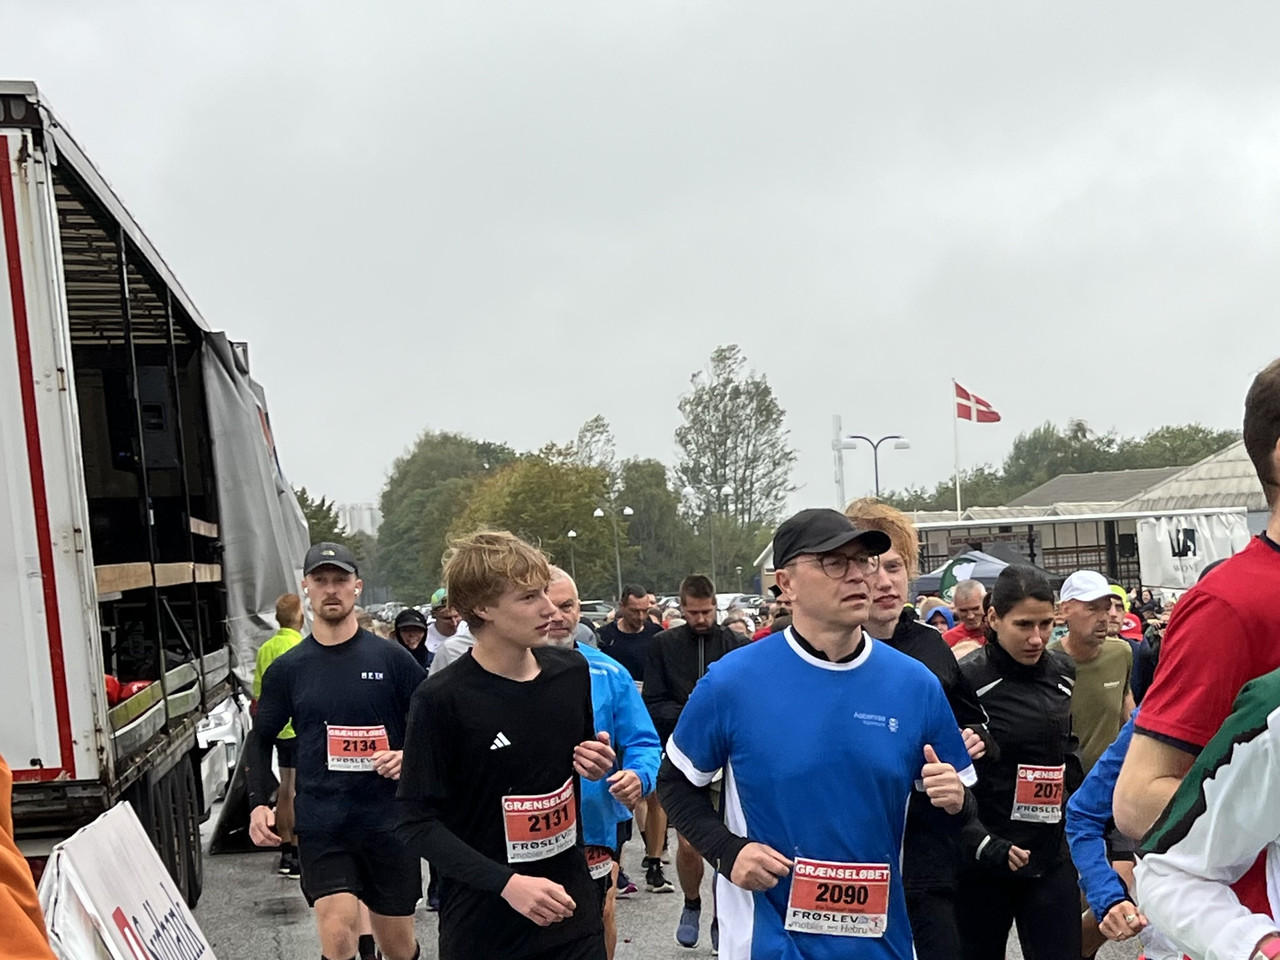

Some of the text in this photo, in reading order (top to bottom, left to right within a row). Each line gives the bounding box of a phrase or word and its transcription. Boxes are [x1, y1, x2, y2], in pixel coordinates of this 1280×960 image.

[342, 739, 377, 752] 2134
[1034, 782, 1063, 799] 207
[527, 804, 569, 833] 2131
[795, 864, 890, 880] GRÆNSELØBET
[815, 883, 869, 905] 2090
[793, 910, 859, 923] FRØSLEV
